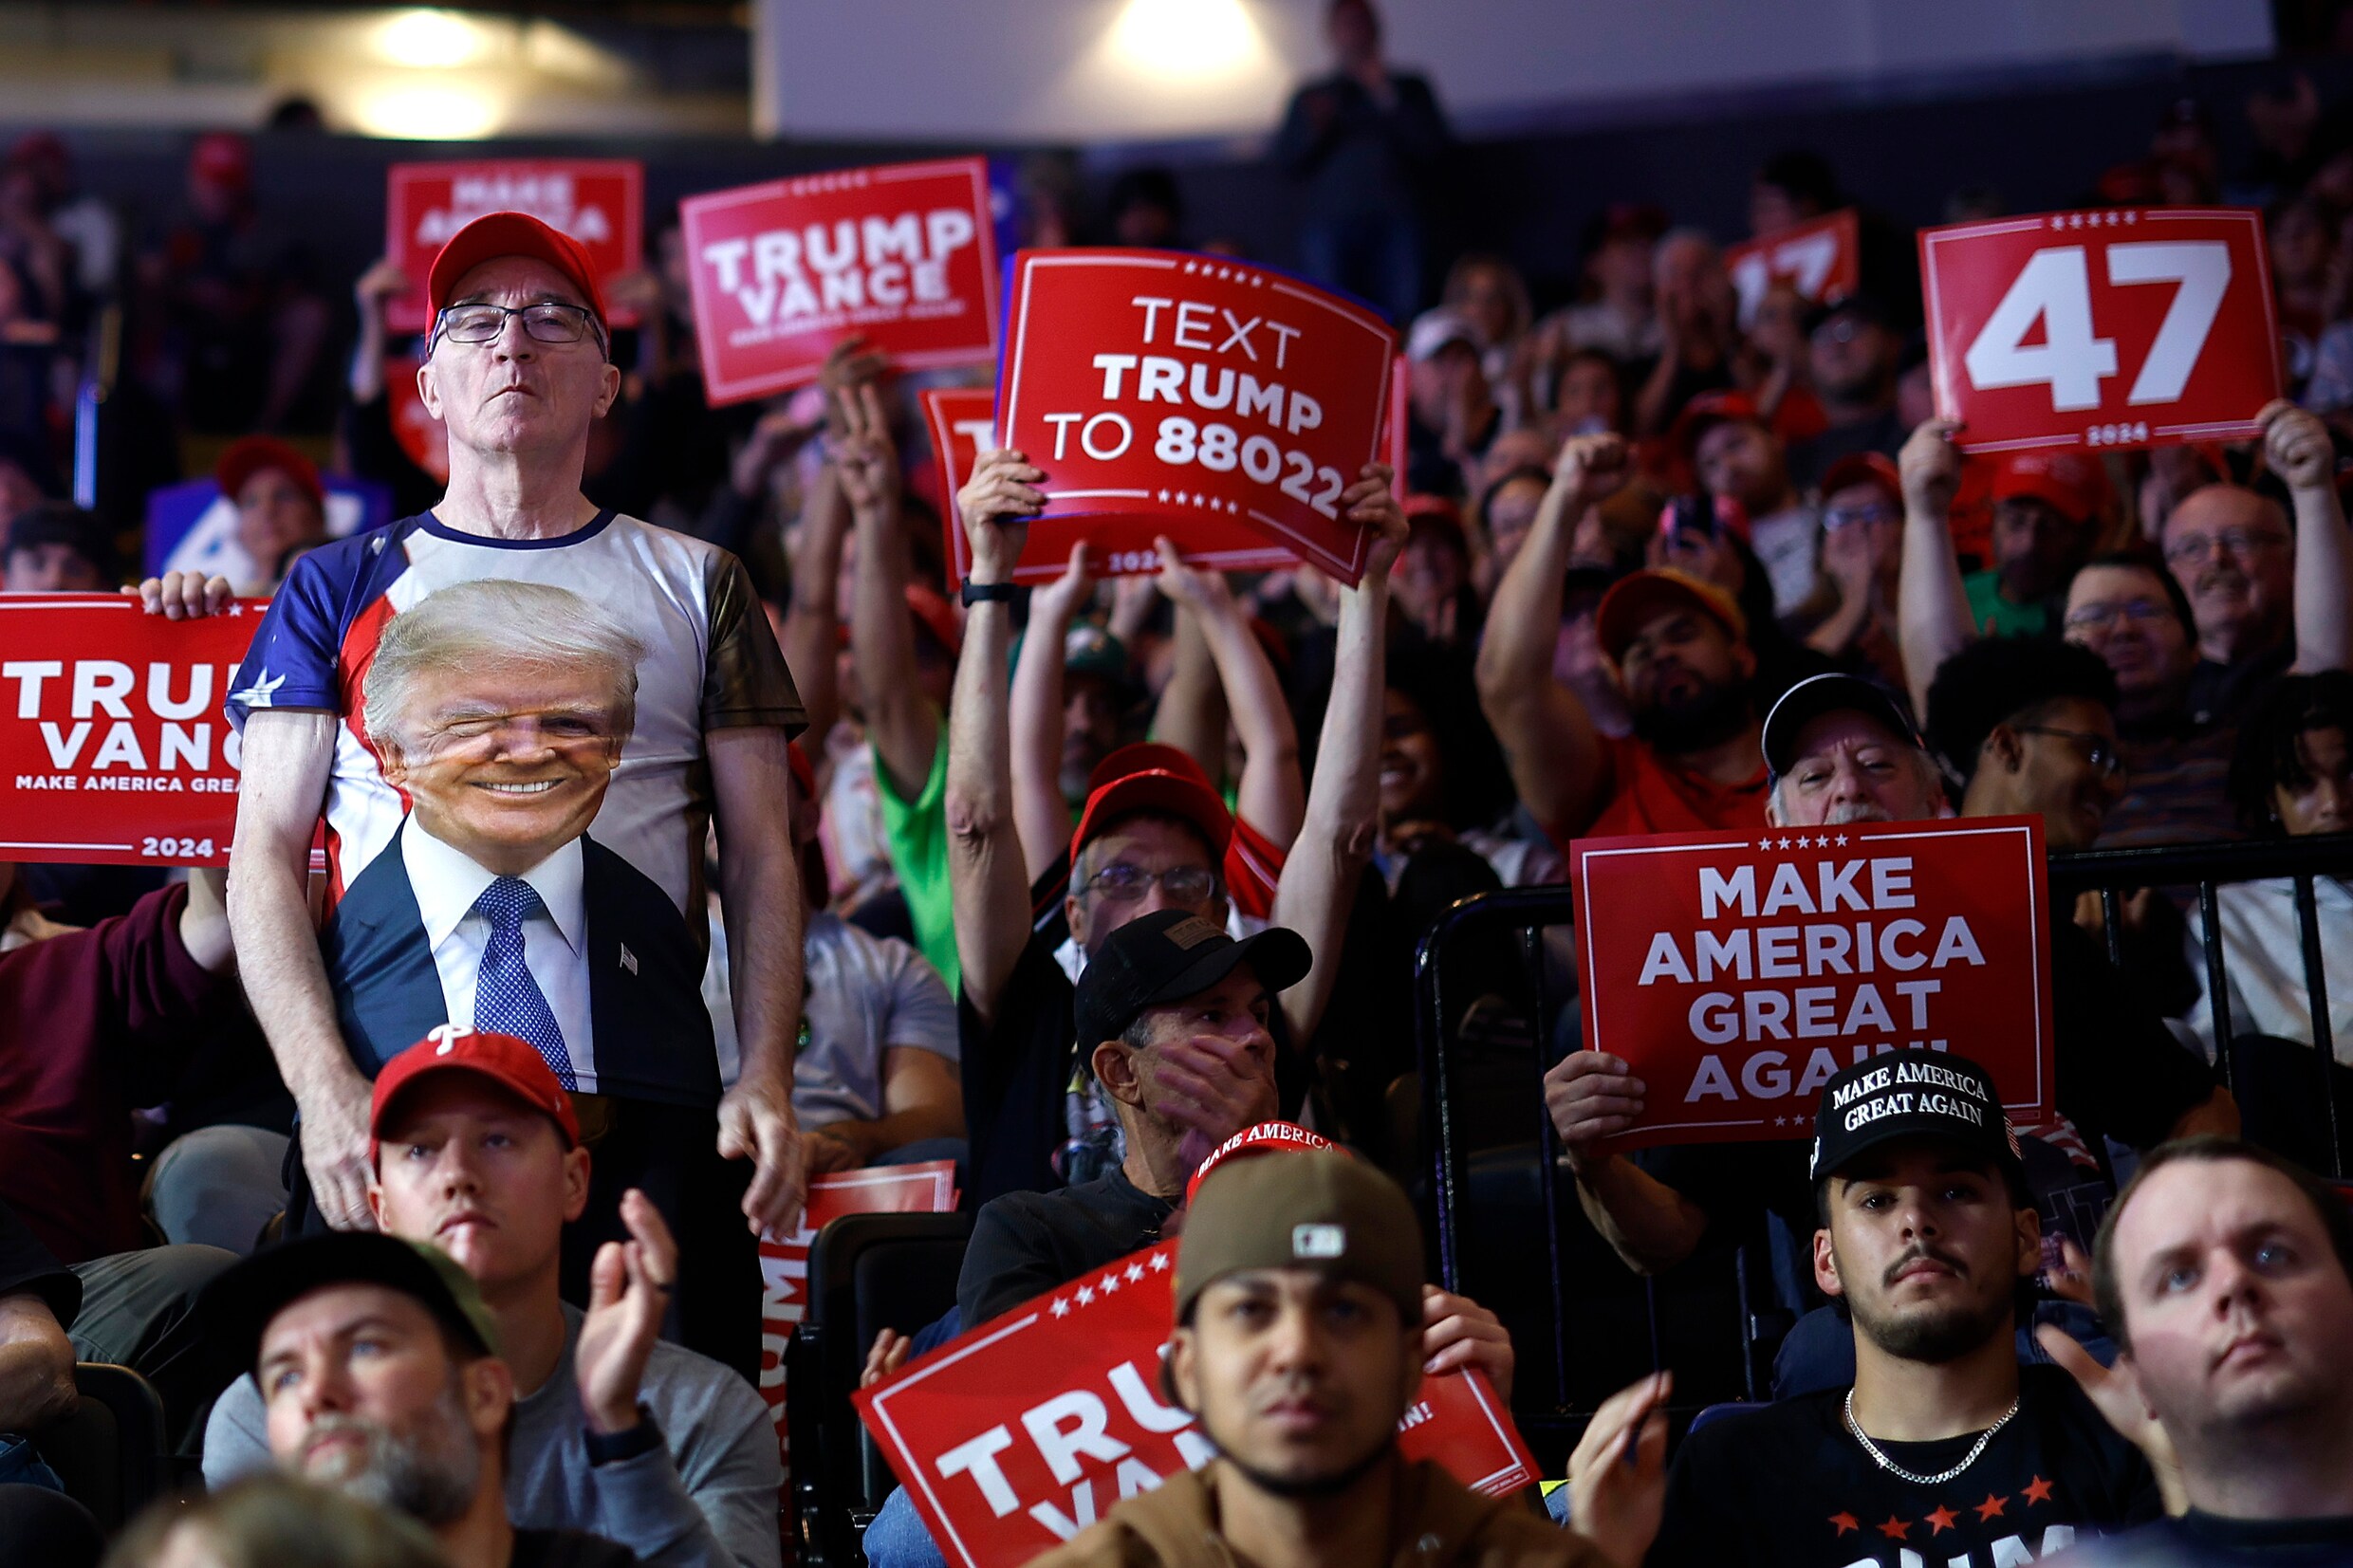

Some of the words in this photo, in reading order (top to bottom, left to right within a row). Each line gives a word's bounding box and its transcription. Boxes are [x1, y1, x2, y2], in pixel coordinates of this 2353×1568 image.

[703, 208, 974, 294] TRUMP
[738, 261, 948, 325] VANCE
[1131, 296, 1302, 370] TEXT
[1964, 240, 2232, 412] 47
[1092, 353, 1324, 435] TRUMP
[2086, 421, 2149, 447] 2024
[1043, 412, 1133, 461] TO
[1154, 415, 1343, 521] 88022
[1108, 550, 1166, 572] 202
[2, 659, 243, 720] TRU
[39, 721, 243, 771] VAN
[16, 775, 77, 790] MAKE
[83, 776, 183, 792] AMERICA
[191, 777, 241, 793] GRE
[141, 837, 214, 858] 2024
[1698, 858, 1916, 920] MAKE
[1637, 915, 1986, 987] AMERICA
[1688, 979, 1942, 1045] GREAT
[1683, 1039, 1948, 1103] AGA
[1833, 1066, 1891, 1111] MAKE
[1896, 1061, 1990, 1102] AMERICA
[1844, 1093, 1914, 1132] GREAT
[1918, 1093, 1983, 1128] AGAIN
[1197, 1133, 1243, 1178] MAKE
[1246, 1123, 1333, 1153] AMERICA
[935, 1341, 1197, 1519] TRU
